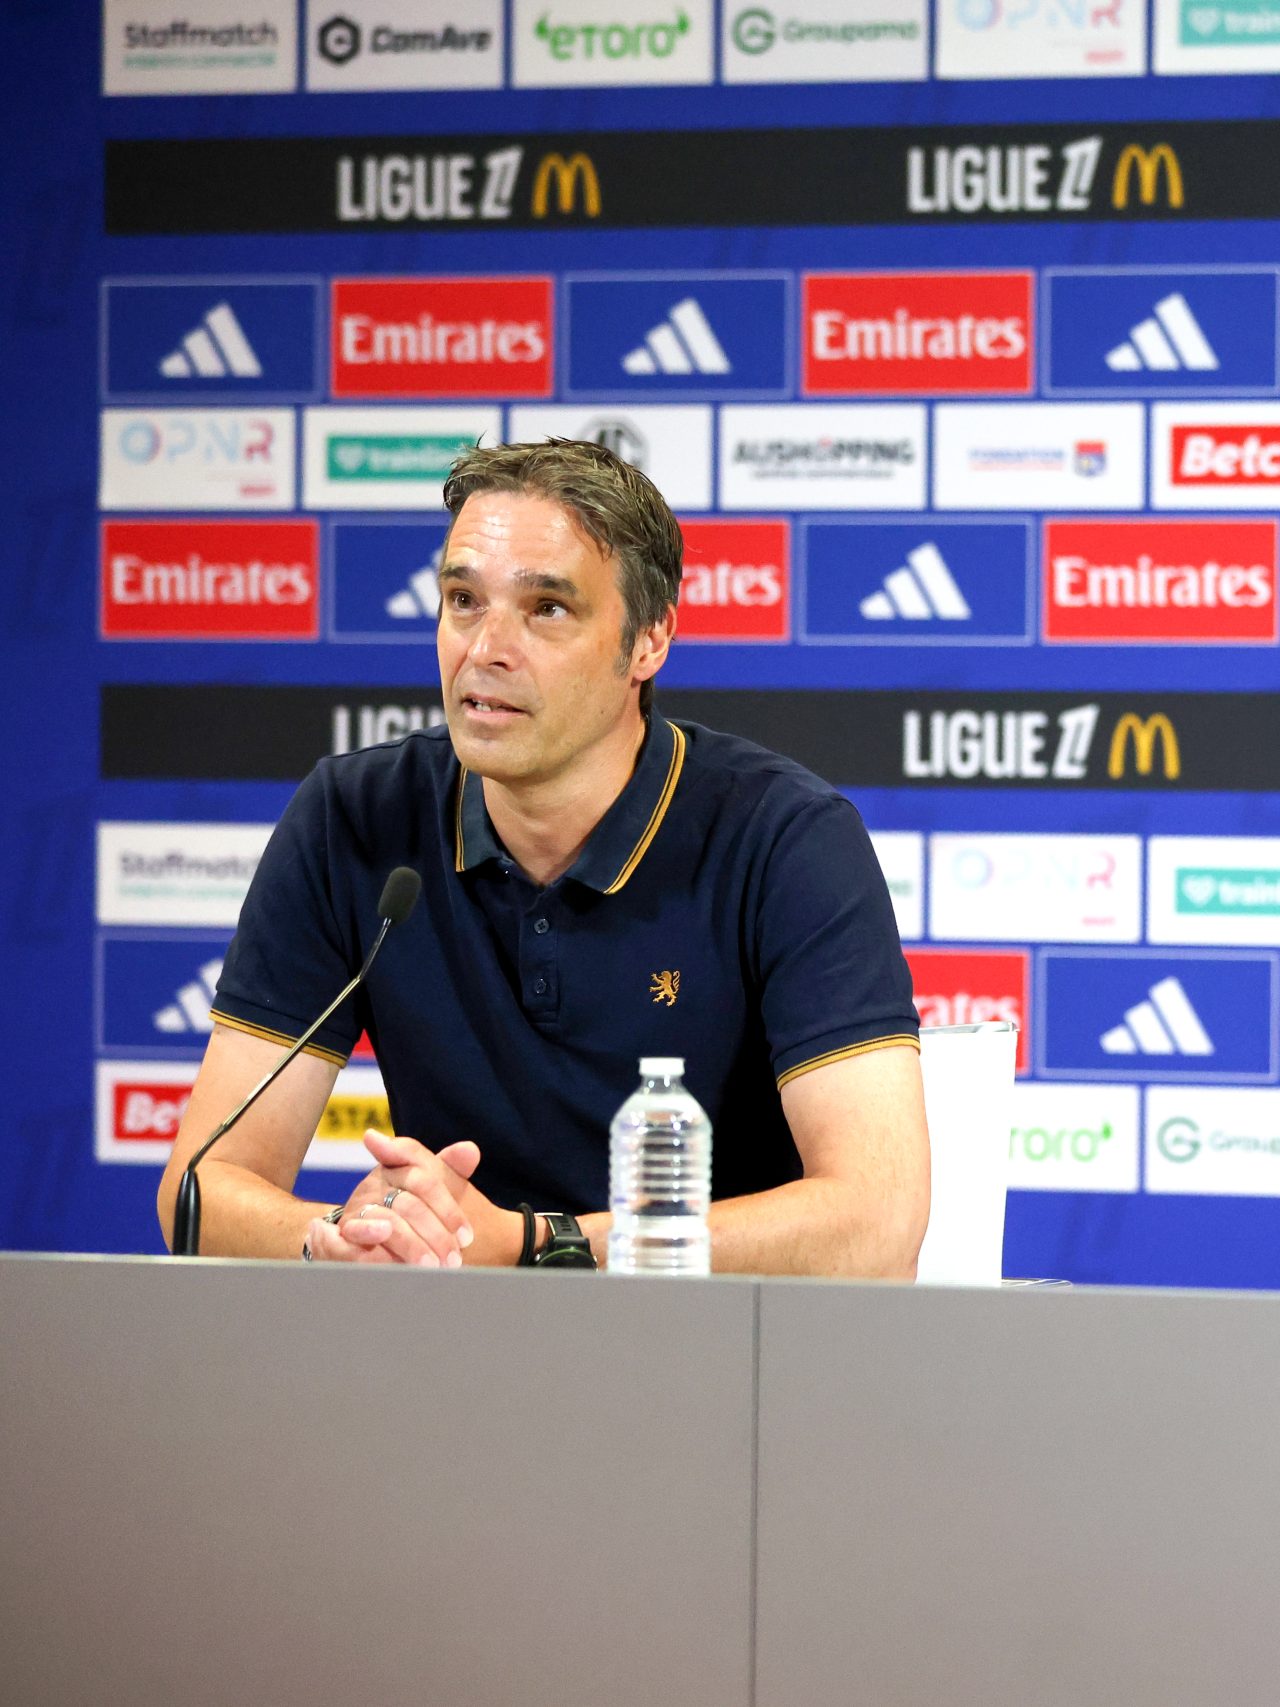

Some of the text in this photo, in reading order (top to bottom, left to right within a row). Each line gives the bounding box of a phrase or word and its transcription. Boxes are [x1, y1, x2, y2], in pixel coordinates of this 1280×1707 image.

[124, 20, 279, 48] Staffmatch
[370, 25, 493, 53] ComAve
[336, 155, 475, 221] LIGUE
[906, 143, 1052, 212] LIGUE
[340, 312, 546, 364] Emirates
[811, 307, 1025, 360] Emirates
[109, 553, 311, 606] Emirates
[682, 560, 781, 606] ates
[1052, 553, 1273, 608] Emirates
[333, 704, 447, 757] LIG
[902, 710, 1049, 779] LIGUE
[120, 850, 262, 880] Staffmatc
